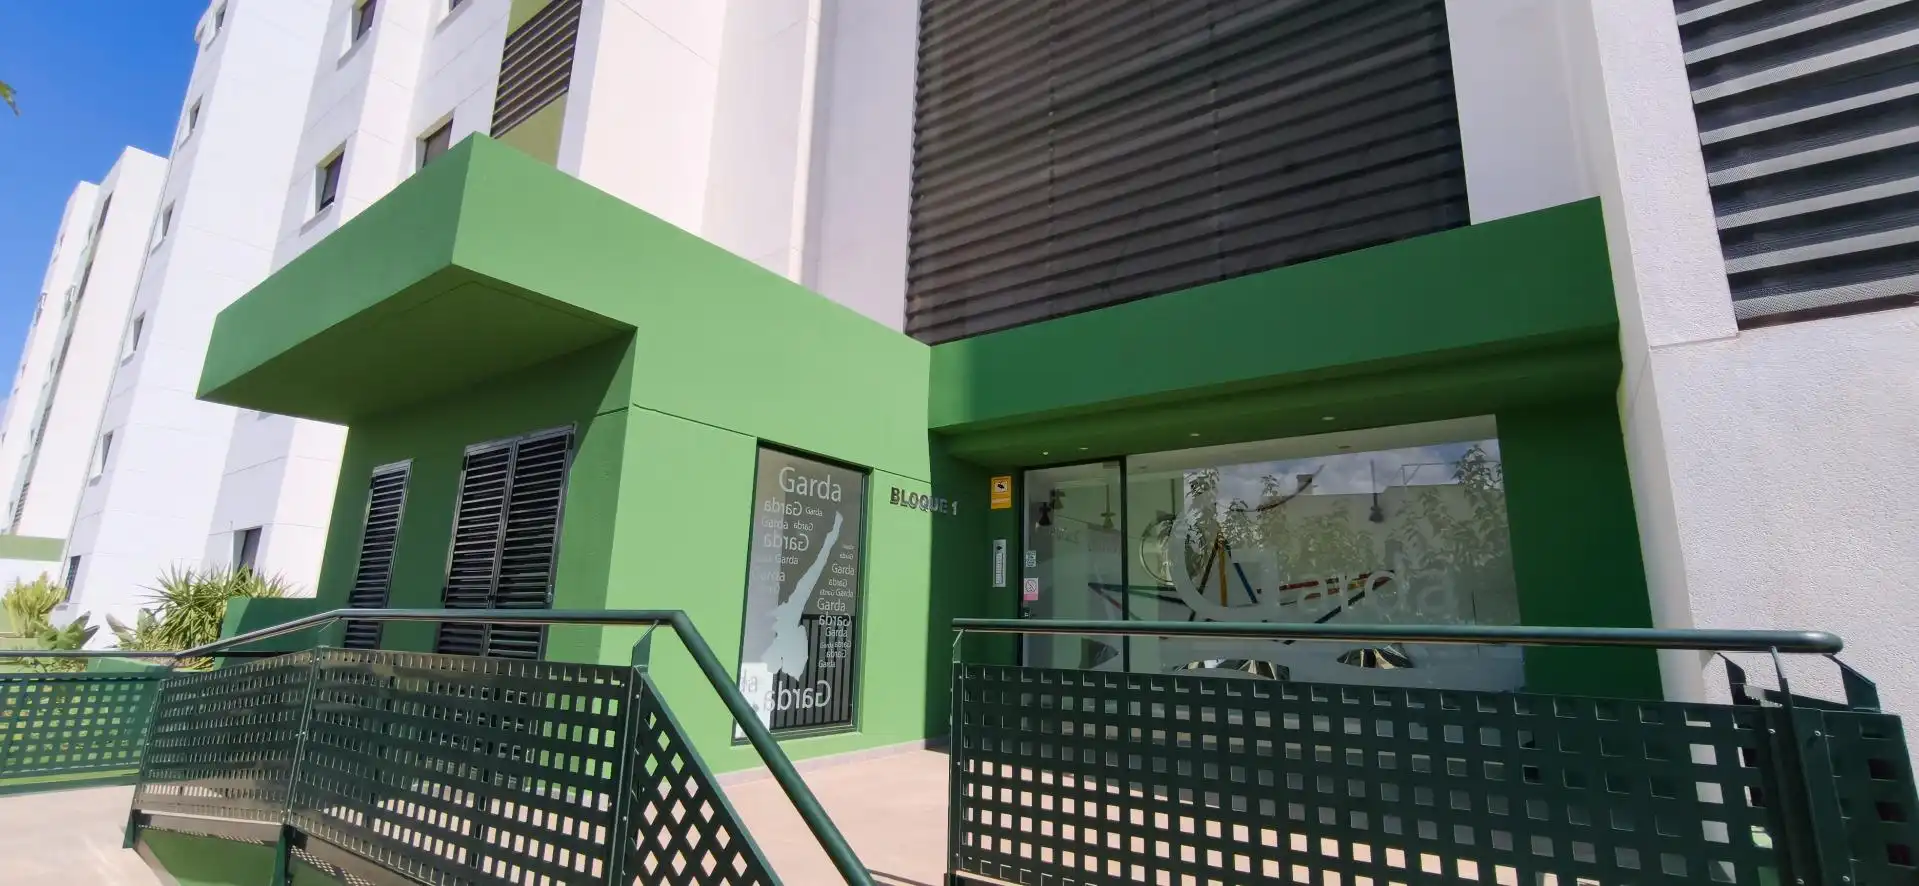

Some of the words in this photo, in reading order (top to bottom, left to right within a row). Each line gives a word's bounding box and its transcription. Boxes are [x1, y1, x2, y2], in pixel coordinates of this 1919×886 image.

[778, 466, 842, 502] Garda
[890, 486, 948, 514] BLOQUE
[951, 500, 958, 515] 1
[805, 507, 823, 517] Garda
[775, 552, 799, 565] Garda
[1167, 494, 1458, 624] Garda
[831, 563, 855, 576] Garda
[817, 597, 846, 611] Garda
[825, 626, 848, 638] Garda
